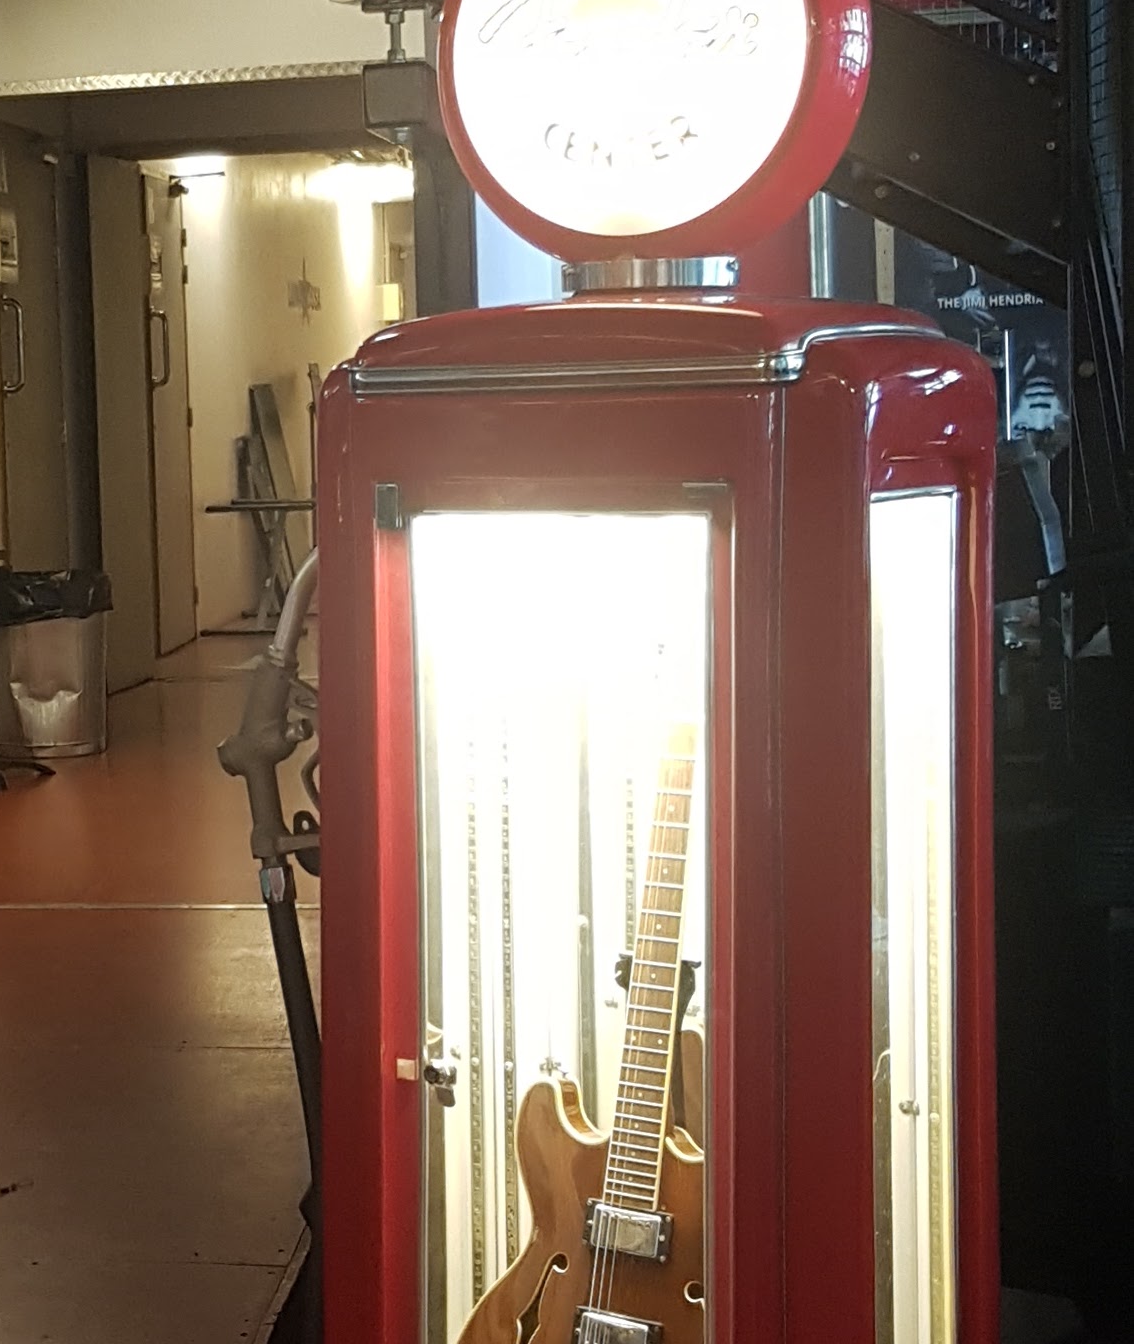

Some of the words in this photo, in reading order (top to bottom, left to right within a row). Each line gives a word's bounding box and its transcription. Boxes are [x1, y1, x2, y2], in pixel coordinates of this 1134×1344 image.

[544, 115, 699, 168] CENER
[937, 297, 961, 310] THE
[962, 297, 986, 310] JIMI
